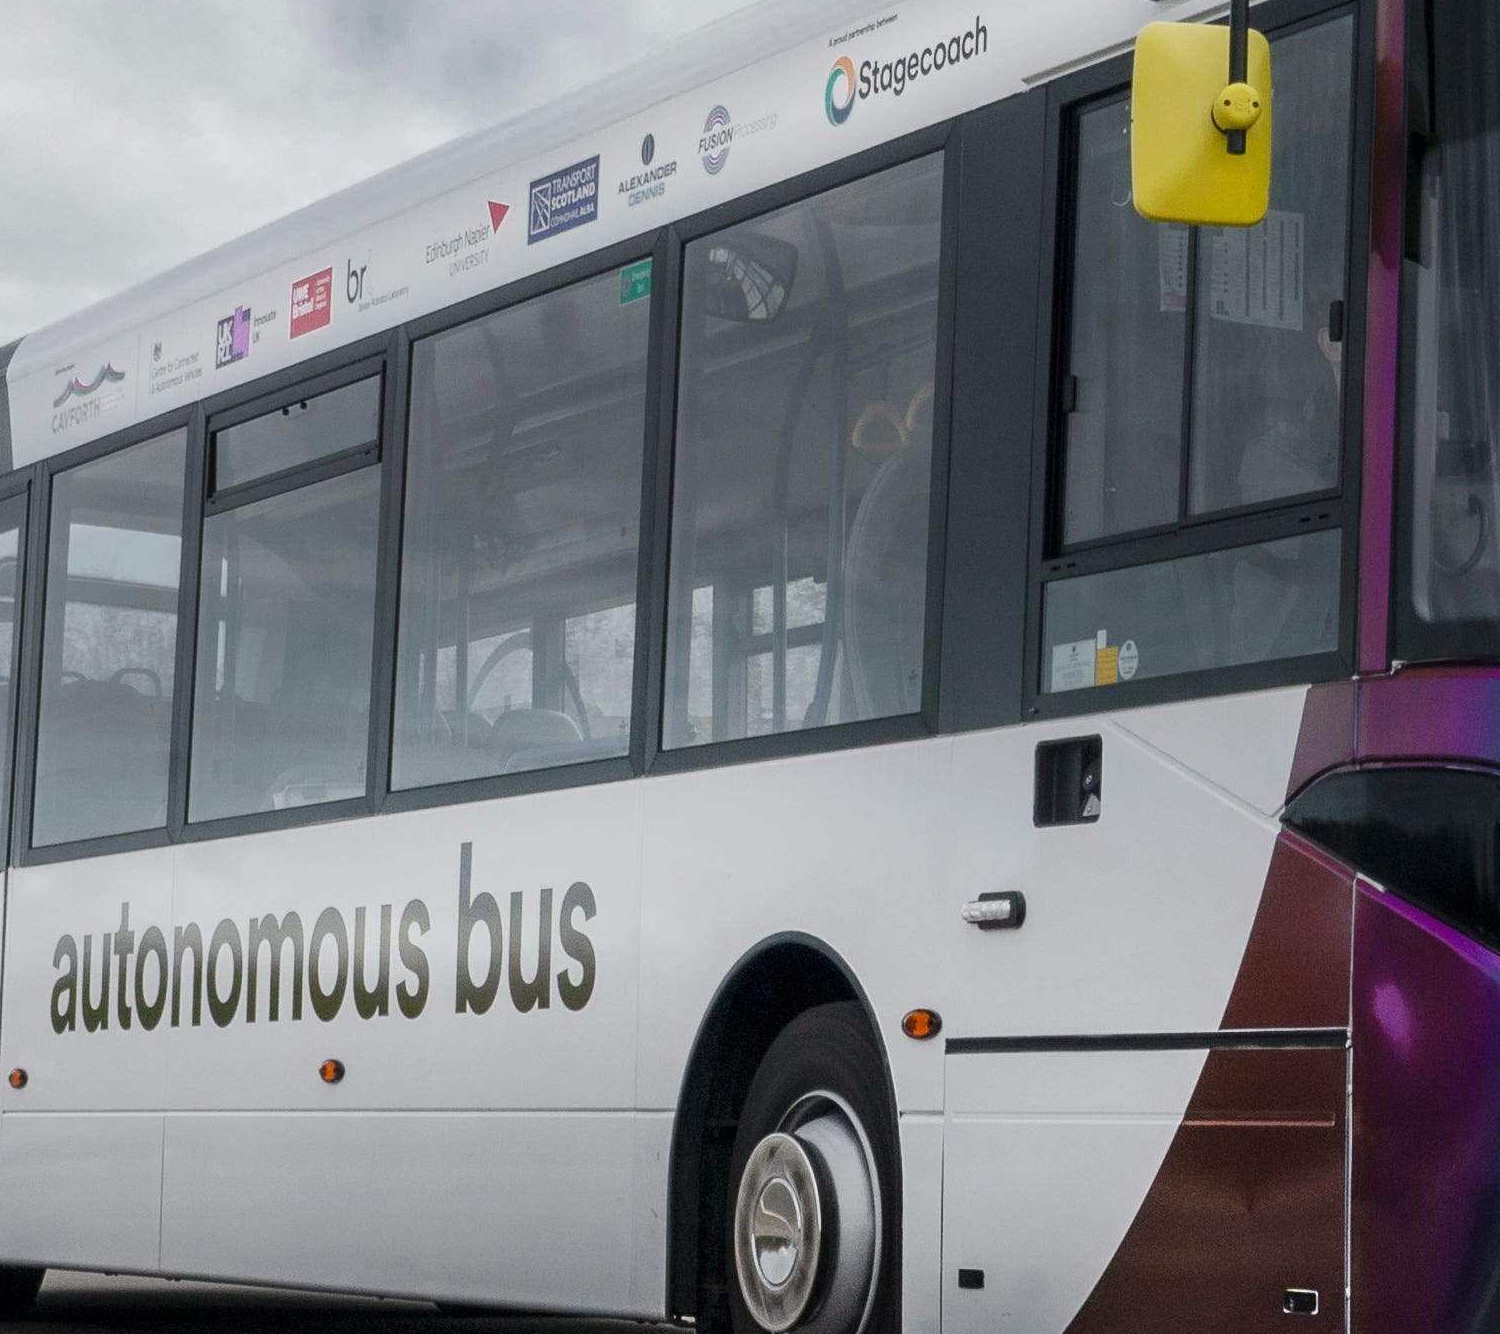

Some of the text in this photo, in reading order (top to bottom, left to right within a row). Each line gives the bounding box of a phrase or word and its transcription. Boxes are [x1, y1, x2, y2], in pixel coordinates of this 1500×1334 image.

[858, 15, 988, 100] Stagecoach
[698, 113, 778, 155] FUSION Processing
[552, 164, 597, 191] TRANSPORT
[618, 161, 678, 195] ALEXANDER
[551, 181, 596, 211] SCOTLAND
[628, 182, 666, 208] DENNIS
[579, 202, 595, 217] ALBA
[426, 224, 491, 264] Edinburgh Napier
[449, 250, 490, 277] UNIVERSITY
[293, 283, 309, 304] UWE
[253, 310, 277, 327] Innovate
[252, 330, 261, 345] UK
[51, 397, 100, 434] CAVFORTH
[50, 841, 597, 1035] autonomous bus
